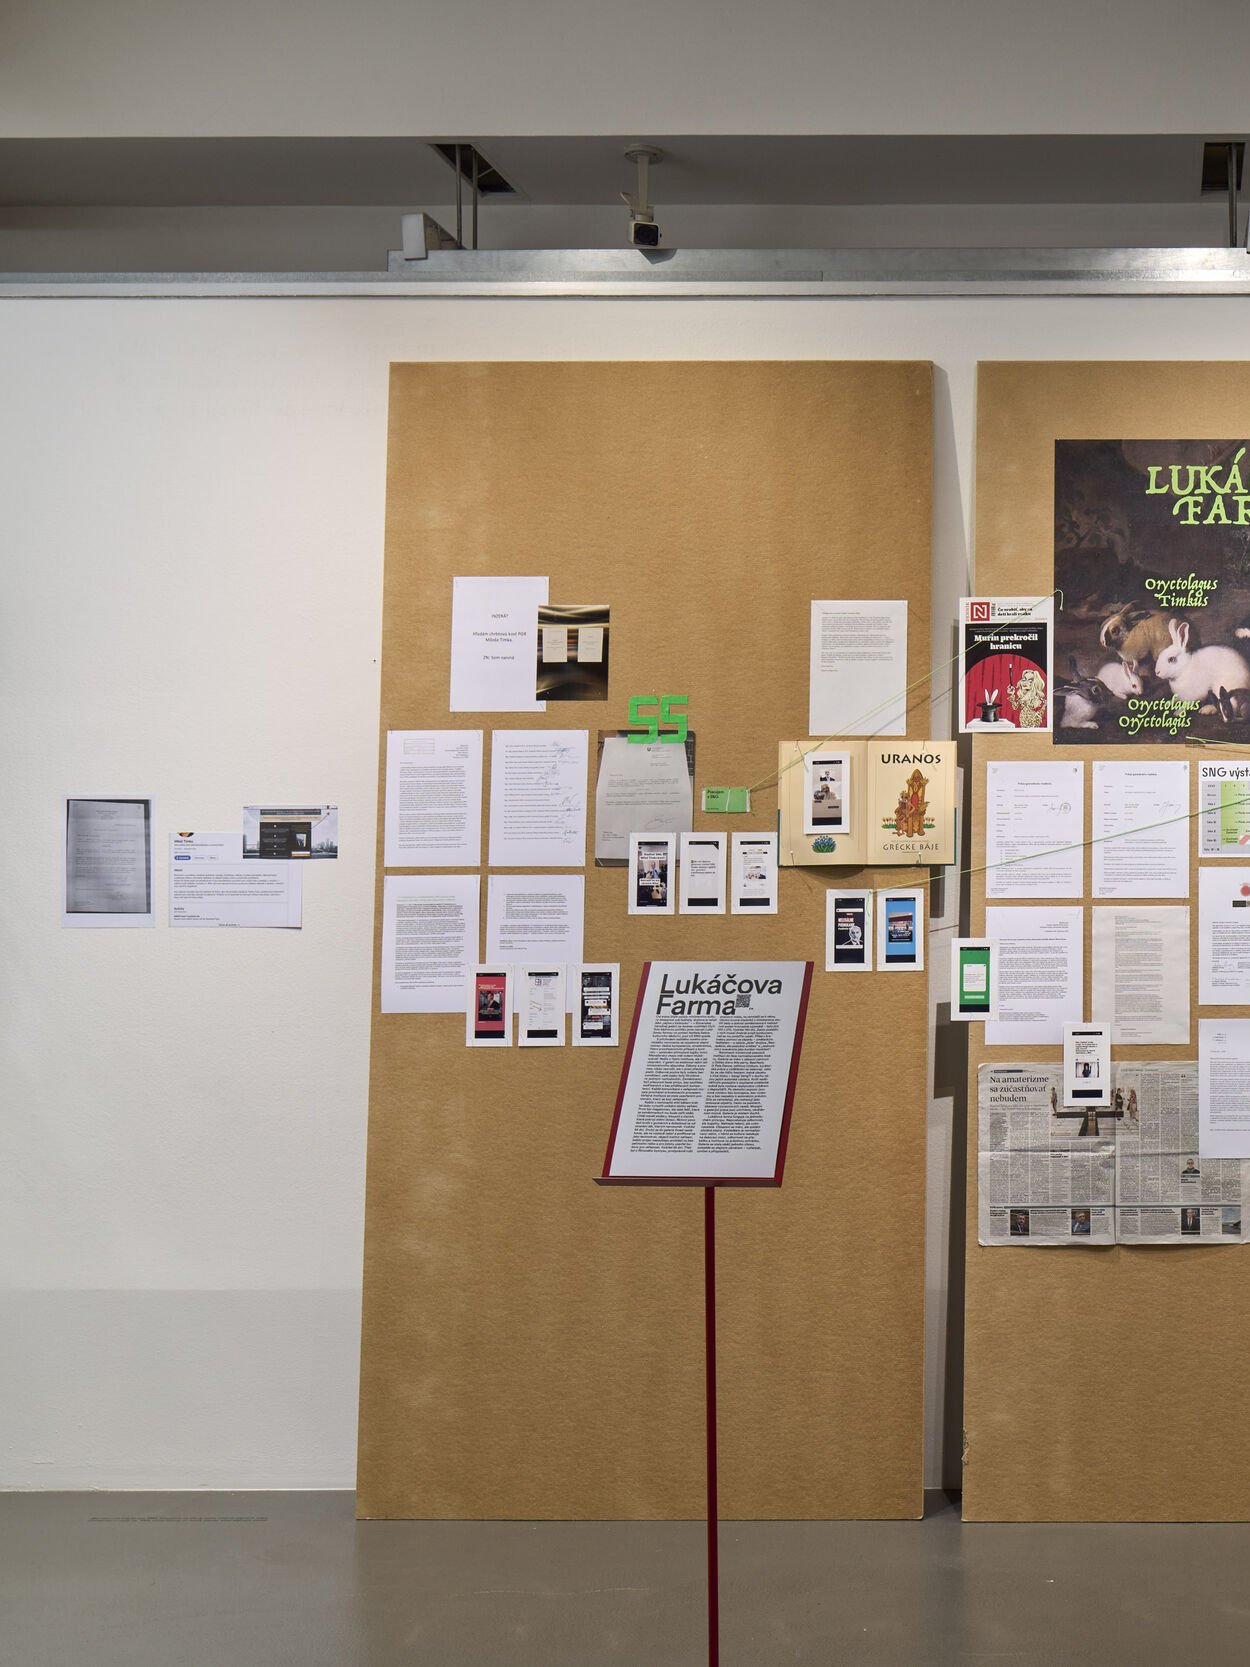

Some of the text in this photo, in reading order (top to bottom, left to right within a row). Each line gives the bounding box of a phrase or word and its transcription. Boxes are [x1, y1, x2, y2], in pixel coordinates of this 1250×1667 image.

[1145, 573, 1218, 598] Oryctolagus
[1159, 590, 1208, 606] Timkus
[1000, 633, 1038, 644] prekročil
[990, 642, 1022, 650] hranicu
[1128, 694, 1200, 717] Oryctolagus
[627, 695, 688, 744] 55
[1119, 710, 1192, 734] Oryctolagus
[881, 753, 942, 764] URANOS
[1202, 767, 1227, 778] SNG
[883, 842, 939, 851] GRÉCKE BÁJE
[661, 973, 782, 994] Lukáčova
[656, 994, 736, 1015] Farma
[1002, 1075, 1049, 1083] amaterizme
[990, 1094, 1027, 1102] nebudem
